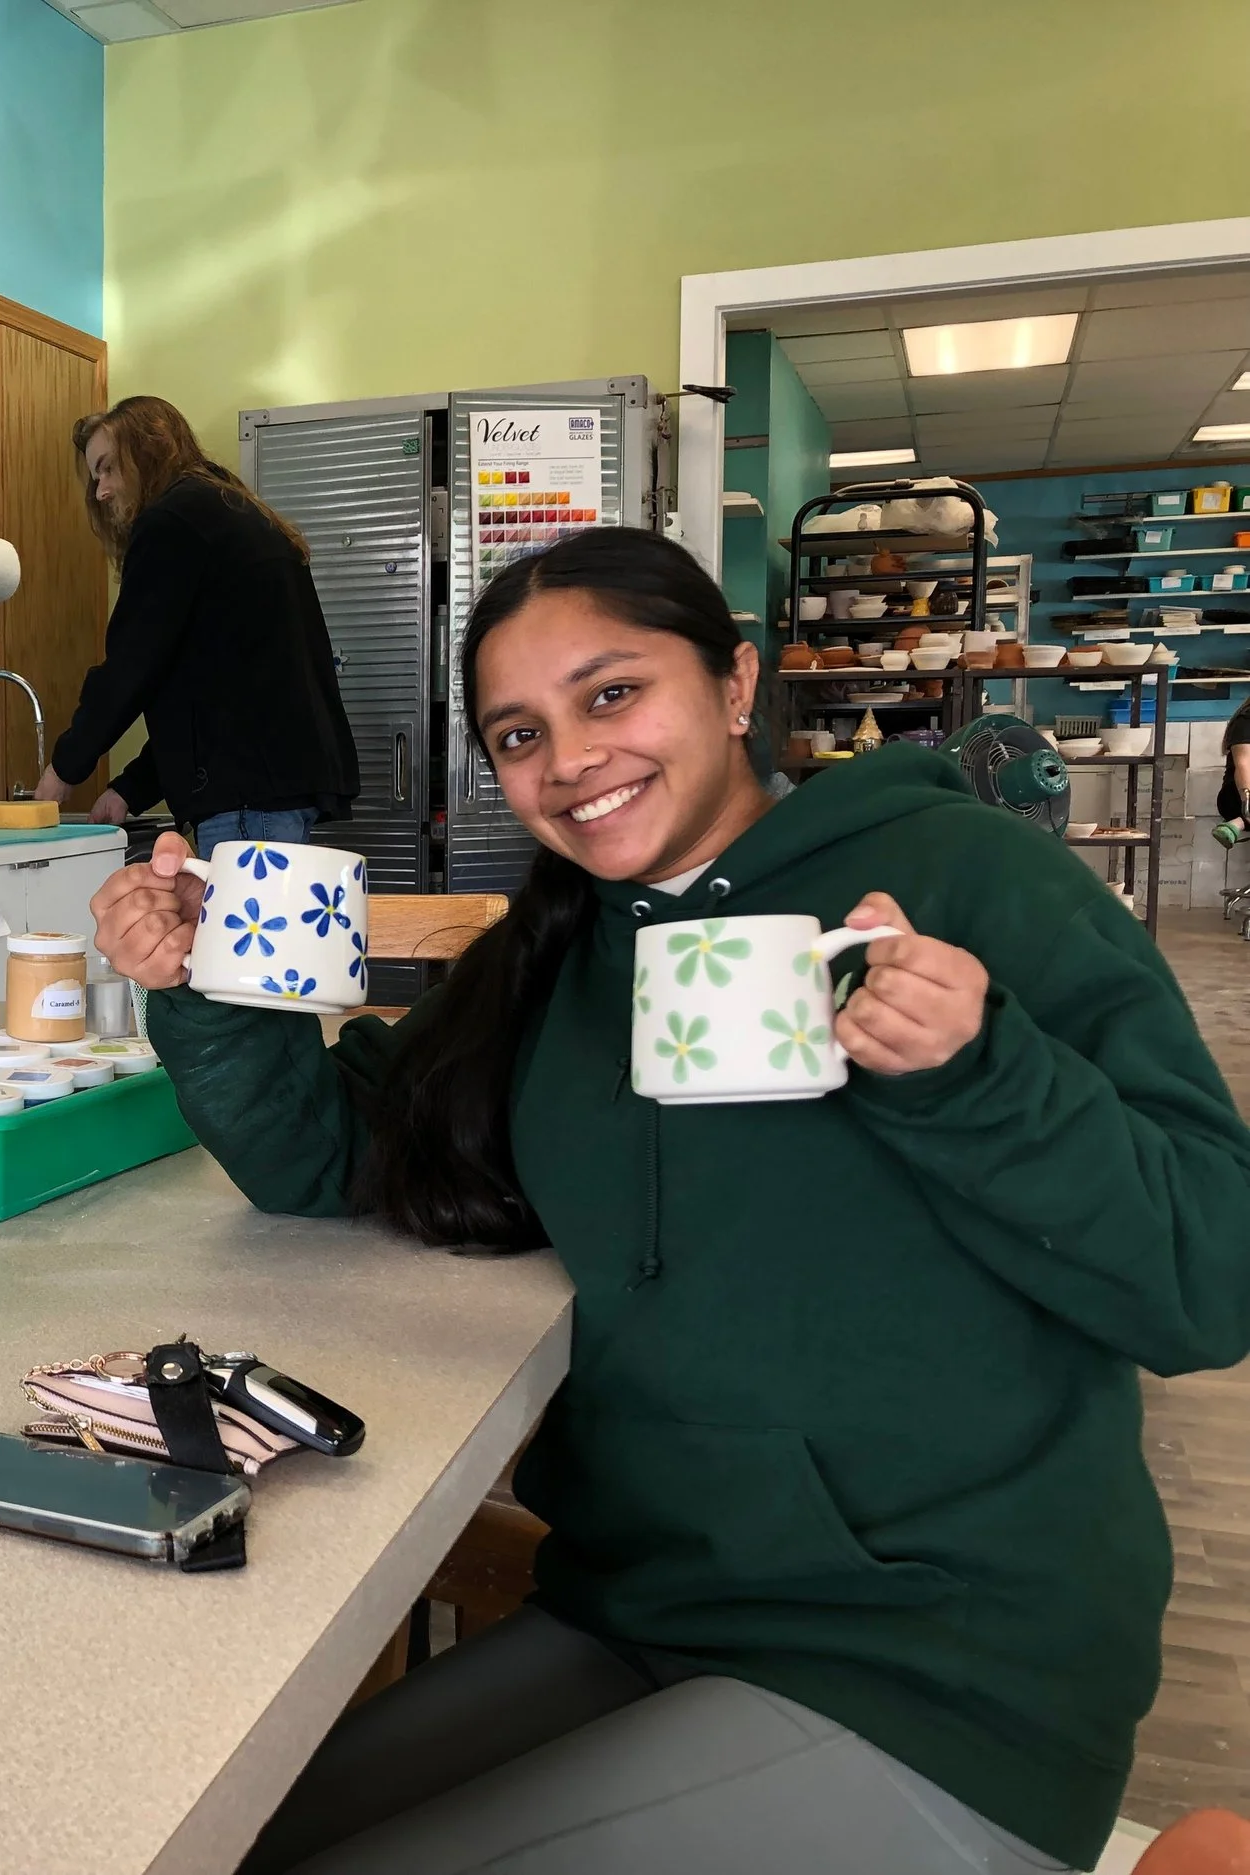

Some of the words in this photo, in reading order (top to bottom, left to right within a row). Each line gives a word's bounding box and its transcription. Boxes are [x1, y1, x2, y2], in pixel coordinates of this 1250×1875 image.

[570, 419, 591, 429] AMACO
[477, 418, 540, 444] Velvet
[49, 1000, 75, 1008] Caramel
